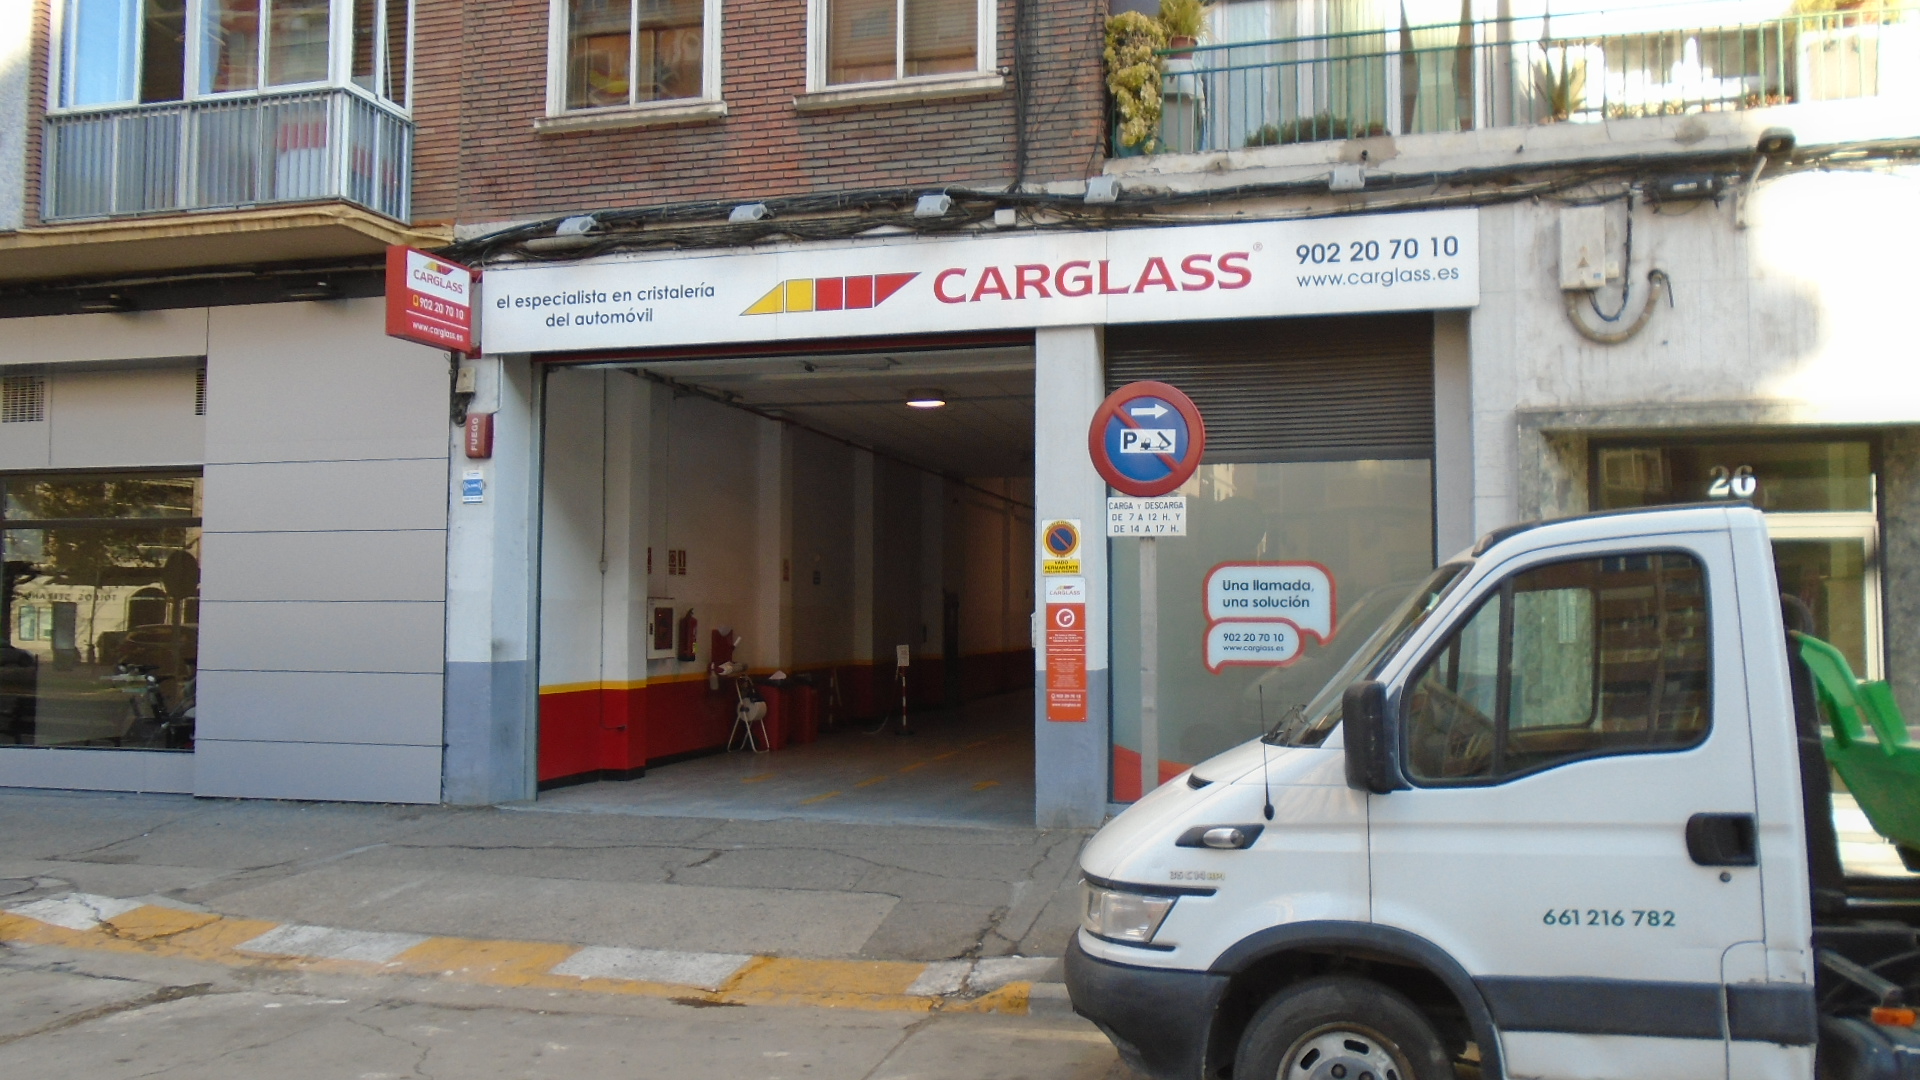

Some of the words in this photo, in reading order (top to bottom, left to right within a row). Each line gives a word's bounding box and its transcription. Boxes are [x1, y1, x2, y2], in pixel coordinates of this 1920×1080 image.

[1296, 242, 1341, 264] 902
[1350, 240, 1380, 262] 20
[1389, 238, 1419, 259] 70
[1431, 235, 1459, 257] 10
[413, 269, 463, 294] CARGLASS
[933, 250, 1253, 304] CARGLASS
[1296, 267, 1460, 287] www.carglass.es
[496, 294, 510, 309] el
[515, 289, 607, 310] especialista
[612, 290, 632, 302] en
[637, 282, 715, 301] cristalería
[419, 297, 433, 311] 902
[434, 302, 443, 315] 20
[445, 305, 454, 317] 70
[456, 308, 464, 320] 10
[545, 312, 570, 328] del
[575, 307, 653, 326] automóvil
[412, 321, 464, 342] www.carglass.es
[470, 417, 479, 452] FUEGO
[1123, 431, 1138, 450] P
[1708, 464, 1757, 497] 26
[1108, 502, 1134, 510] CARGA
[1144, 501, 1184, 510] DESCARGA
[1112, 513, 1123, 521] DE
[1129, 513, 1135, 521] 7
[1138, 513, 1144, 521] A
[1148, 513, 1158, 521] 12
[1162, 513, 1171, 521] H.
[1175, 513, 1181, 521] Y
[1114, 525, 1125, 533] DE
[1130, 525, 1140, 533] 14
[1144, 525, 1151, 533] A
[1222, 579, 1249, 591] Una
[1252, 579, 1314, 592] llamada,
[1222, 598, 1249, 608] una
[1252, 595, 1310, 608] solución
[1223, 633, 1241, 642] 902
[1243, 633, 1256, 642] 20
[1258, 633, 1270, 641] 70
[1273, 633, 1284, 641] 10
[1222, 645, 1284, 653] www.carglass.es
[1543, 909, 1580, 926] 661
[1587, 909, 1625, 927] 216
[1632, 910, 1676, 927] 782
